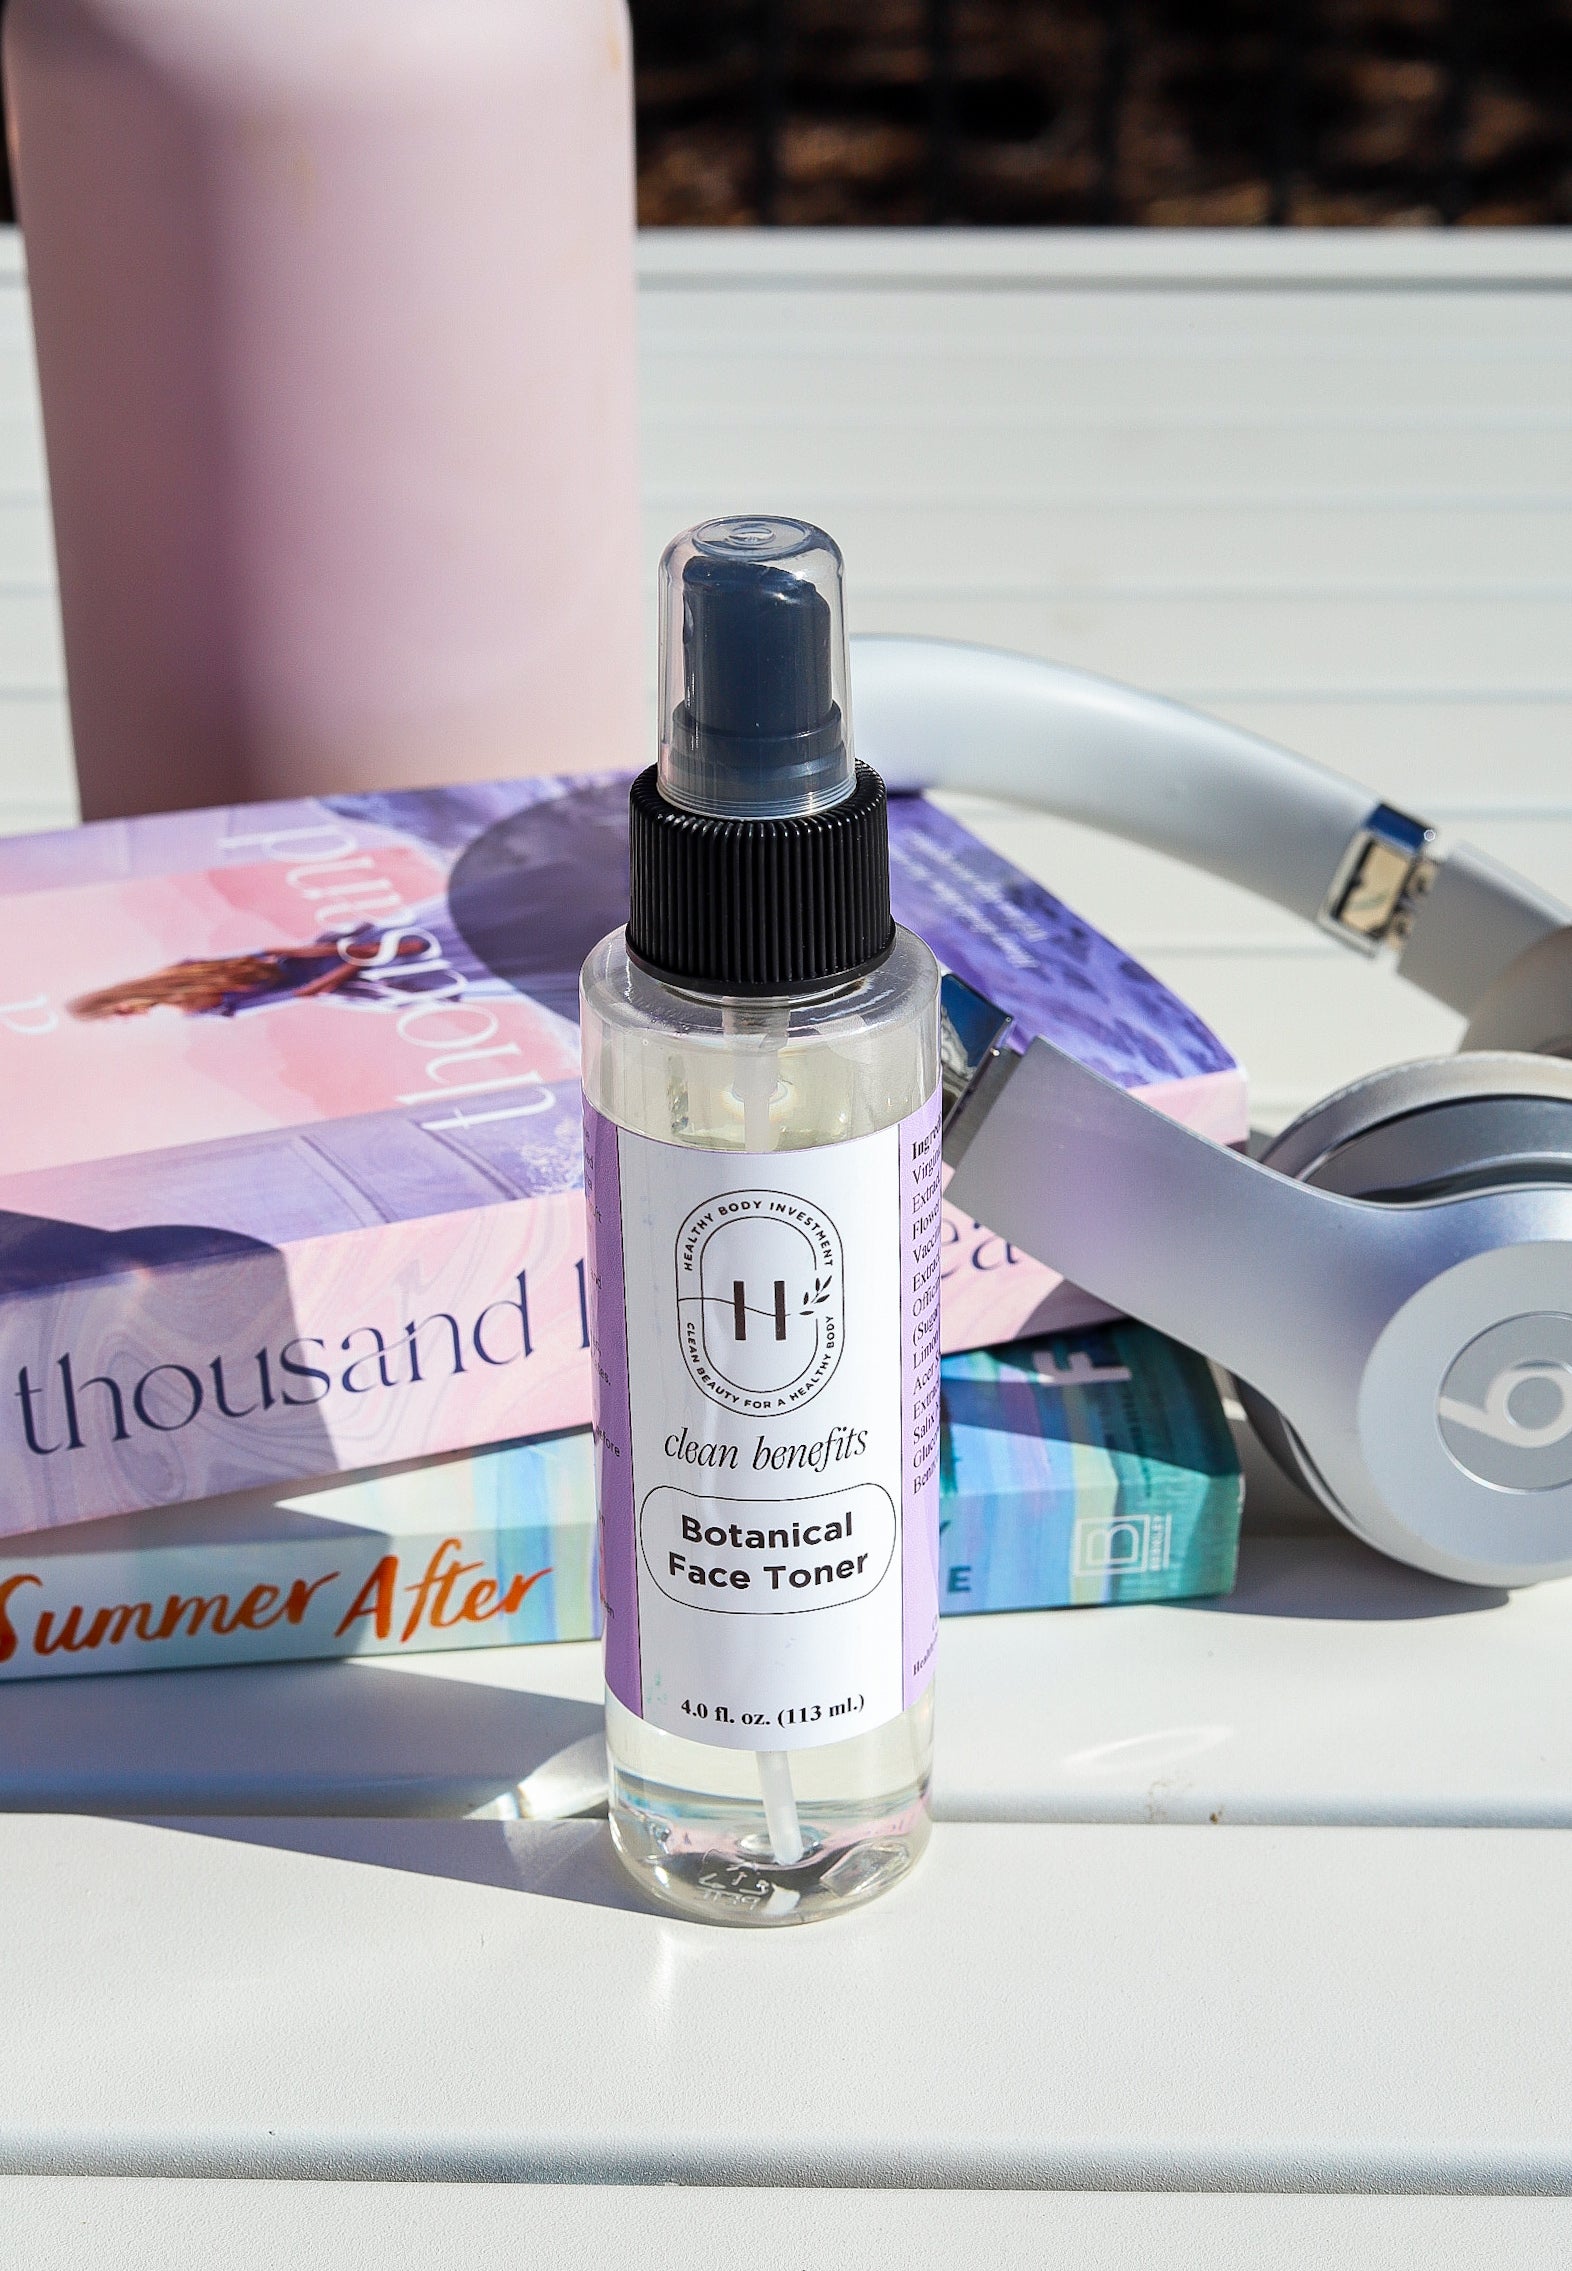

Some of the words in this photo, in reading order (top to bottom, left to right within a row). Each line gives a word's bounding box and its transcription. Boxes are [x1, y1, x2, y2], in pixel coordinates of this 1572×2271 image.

[683, 1213, 714, 1271] HEALTHY
[718, 1200, 762, 1215] BODY
[769, 1202, 833, 1267] INVESTMENT
[14, 1271, 533, 1456] thousand
[686, 1322, 700, 1364] CLEAN
[696, 1366, 740, 1404] BEAUTY
[744, 1399, 772, 1410] FOR
[777, 1399, 787, 1408] A
[789, 1353, 833, 1402] HEALTHY
[825, 1315, 835, 1349] BODY
[664, 1427, 739, 1469] clean
[752, 1426, 868, 1473] benefits
[681, 1511, 853, 1549] Botanical
[668, 1551, 751, 1590] Face
[763, 1553, 869, 1590] Toner
[0, 1570, 341, 1663] Summer
[334, 1538, 555, 1644] After
[680, 1698, 708, 1719] 4.0
[714, 1706, 735, 1724] fl.
[741, 1711, 770, 1726] oz.
[777, 1705, 822, 1728] (113
[828, 1693, 865, 1718] ml.)
